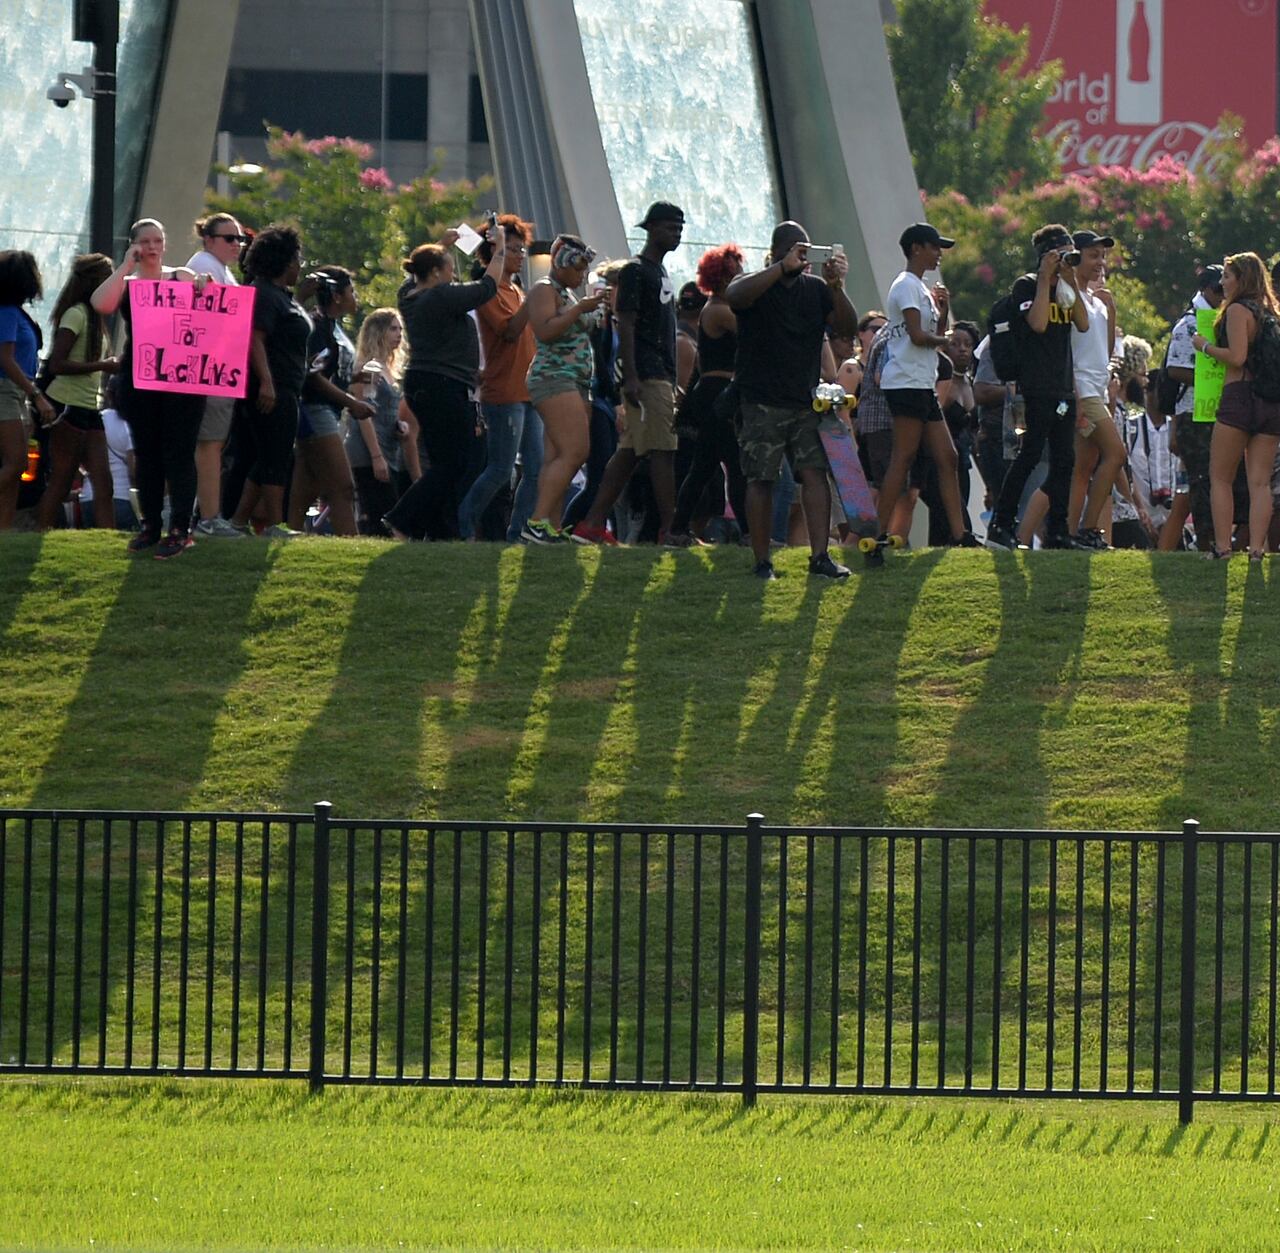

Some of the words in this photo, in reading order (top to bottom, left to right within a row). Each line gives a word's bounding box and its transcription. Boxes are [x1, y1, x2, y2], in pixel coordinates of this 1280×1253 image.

[1046, 72, 1110, 104] orld
[1085, 104, 1109, 125] of
[172, 313, 206, 347] For
